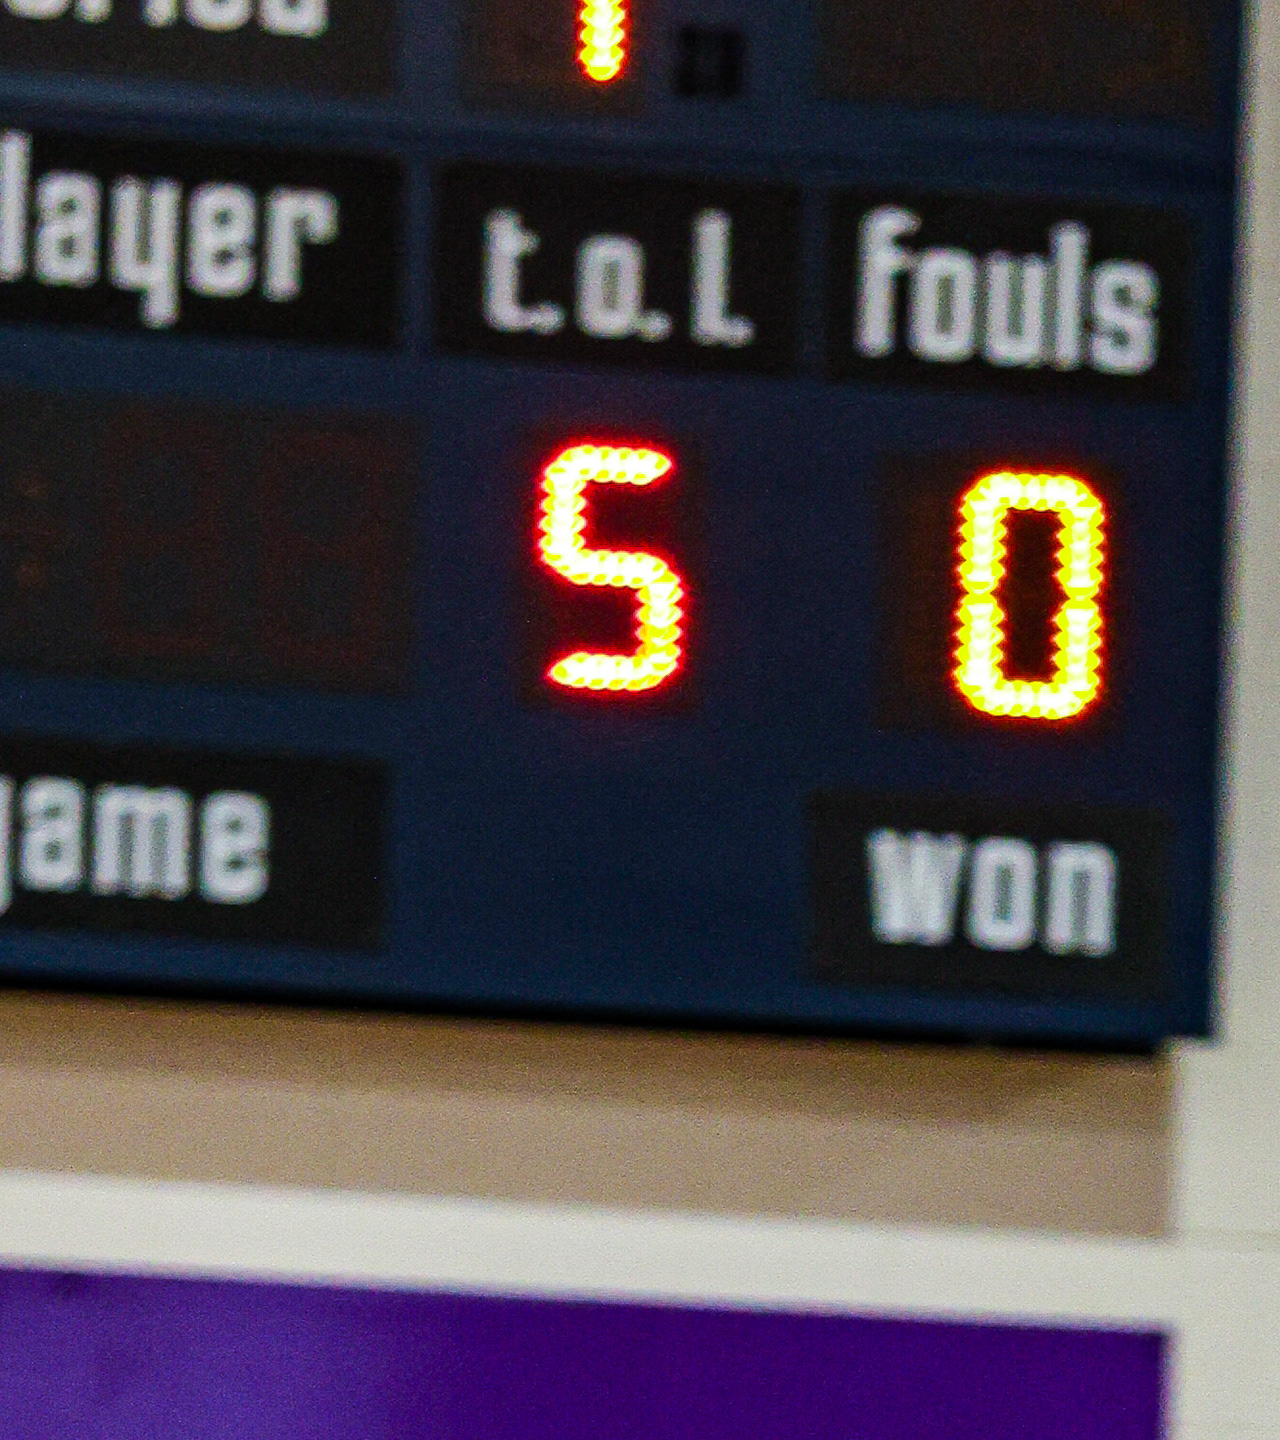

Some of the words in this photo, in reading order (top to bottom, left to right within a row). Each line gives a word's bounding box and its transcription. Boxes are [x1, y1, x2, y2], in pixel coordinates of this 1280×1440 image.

[863, 212, 1151, 370] fouls
[539, 445, 682, 691] 5
[954, 472, 1104, 719] 0
[873, 833, 1112, 949] won
